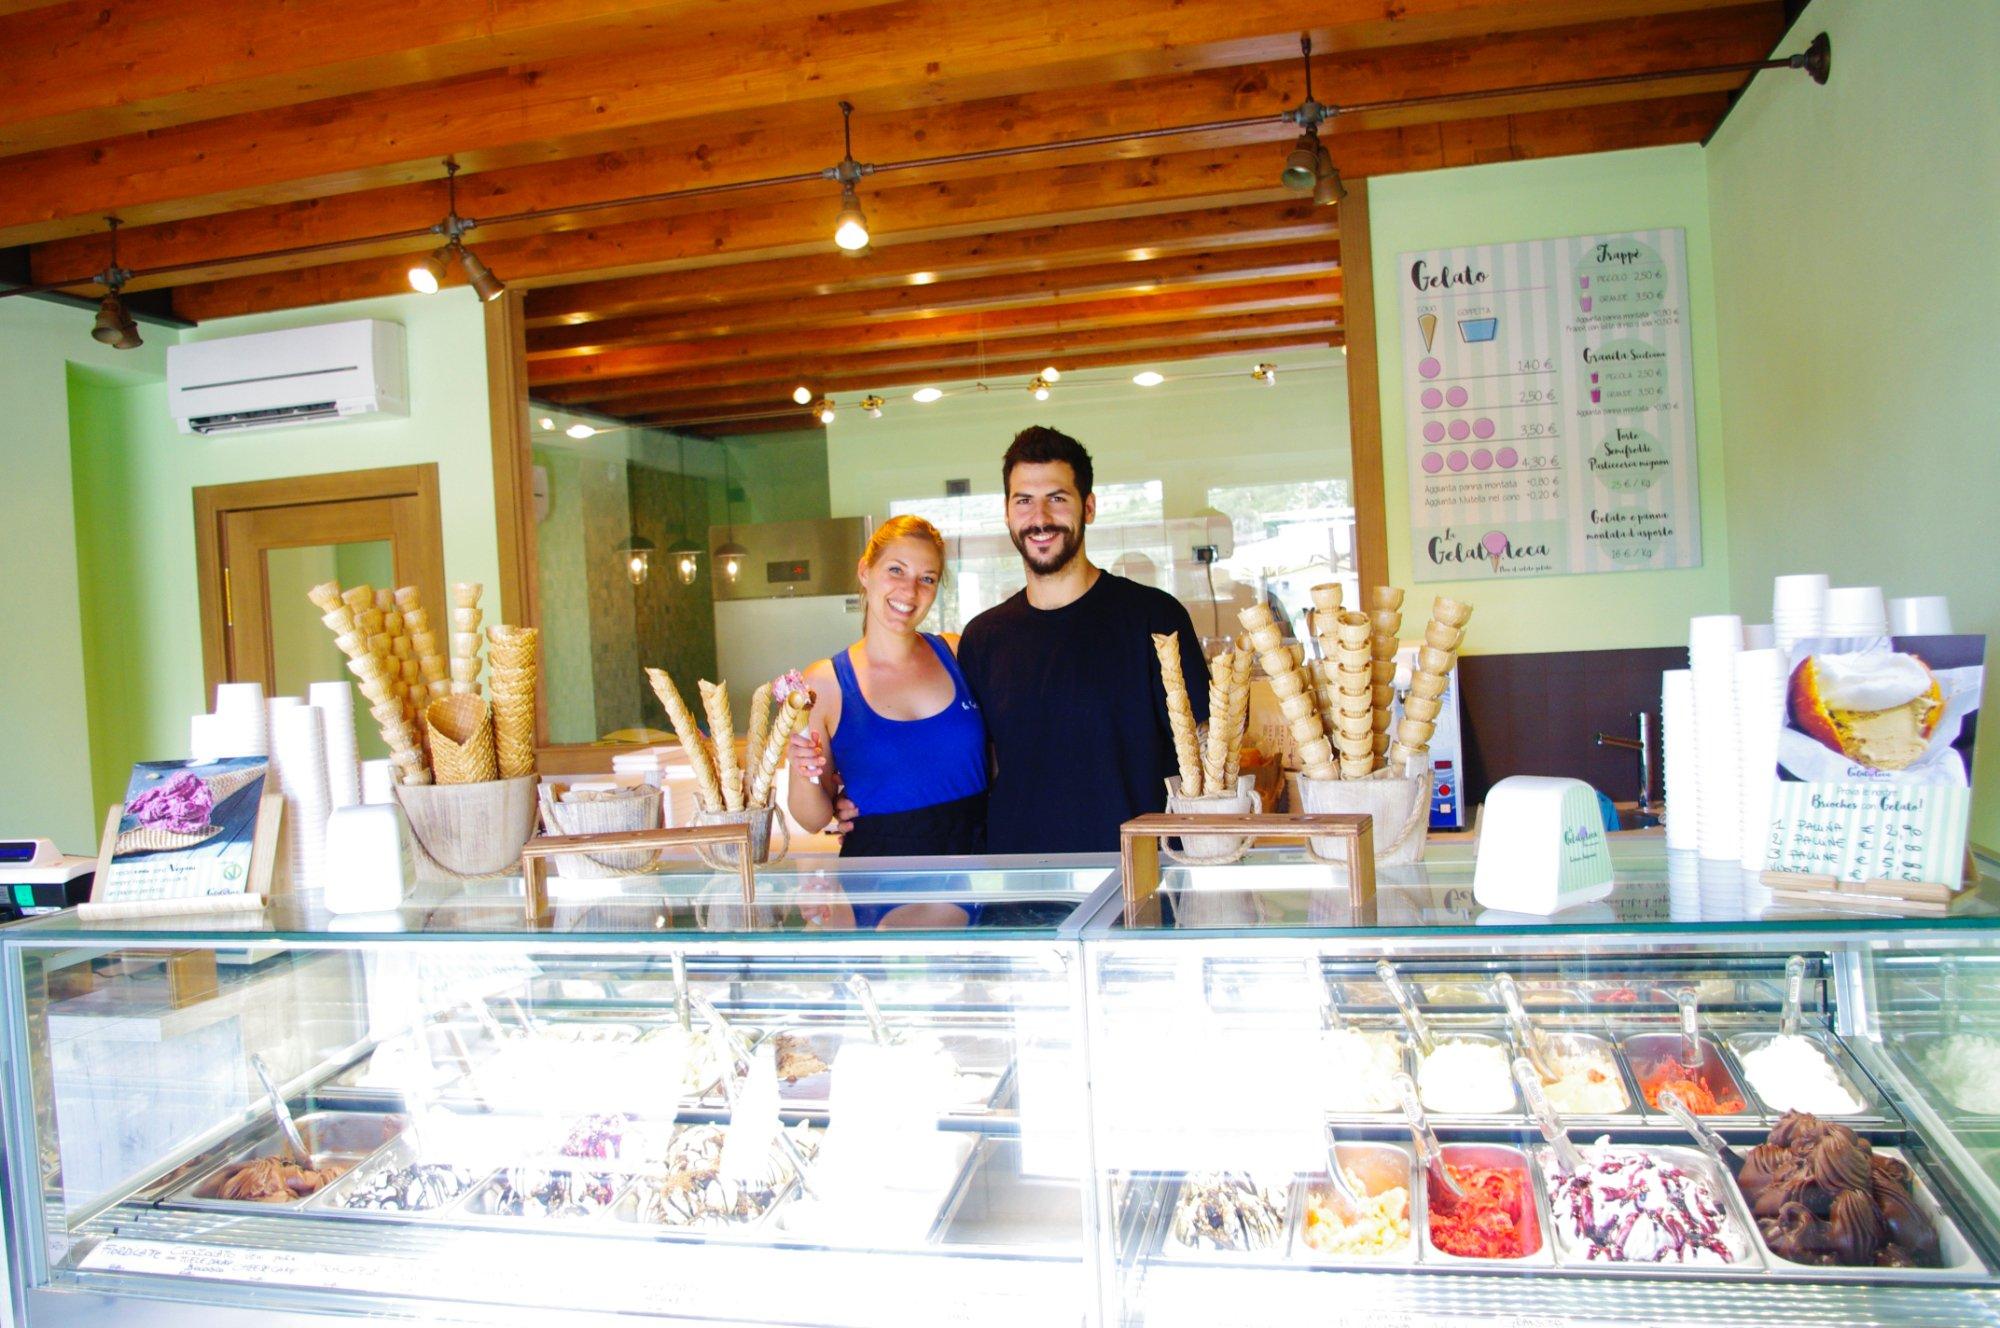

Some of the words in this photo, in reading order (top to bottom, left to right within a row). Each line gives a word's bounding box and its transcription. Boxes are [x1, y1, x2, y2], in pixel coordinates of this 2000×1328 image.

[1411, 260, 1489, 291] Gelato
[1655, 269, 1662, 279] €
[1656, 290, 1663, 299] €
[1458, 308, 1491, 316] COPPETTA
[1583, 348, 1627, 364] Granita
[1544, 358, 1553, 369] €
[1519, 391, 1542, 402] 2,50
[1547, 389, 1556, 400] €
[1521, 424, 1544, 436] 3,50
[1548, 423, 1557, 434] €
[1616, 428, 1639, 441] Torte
[1551, 455, 1559, 466] €
[1485, 481, 1518, 489] montata
[1552, 476, 1559, 485] €
[1552, 490, 1559, 499] €
[1590, 510, 1626, 524] Gelato
[1586, 529, 1626, 540] montata
[1811, 794, 1857, 810] Brioches
[1880, 796, 1923, 811] Gelato!
[1772, 819, 1785, 830] 1
[1861, 825, 1874, 834] €
[1772, 832, 1782, 845] 2
[1858, 840, 1873, 850] €
[1767, 849, 1781, 860] 3
[1854, 856, 1869, 865] €
[1848, 870, 1864, 880] €
